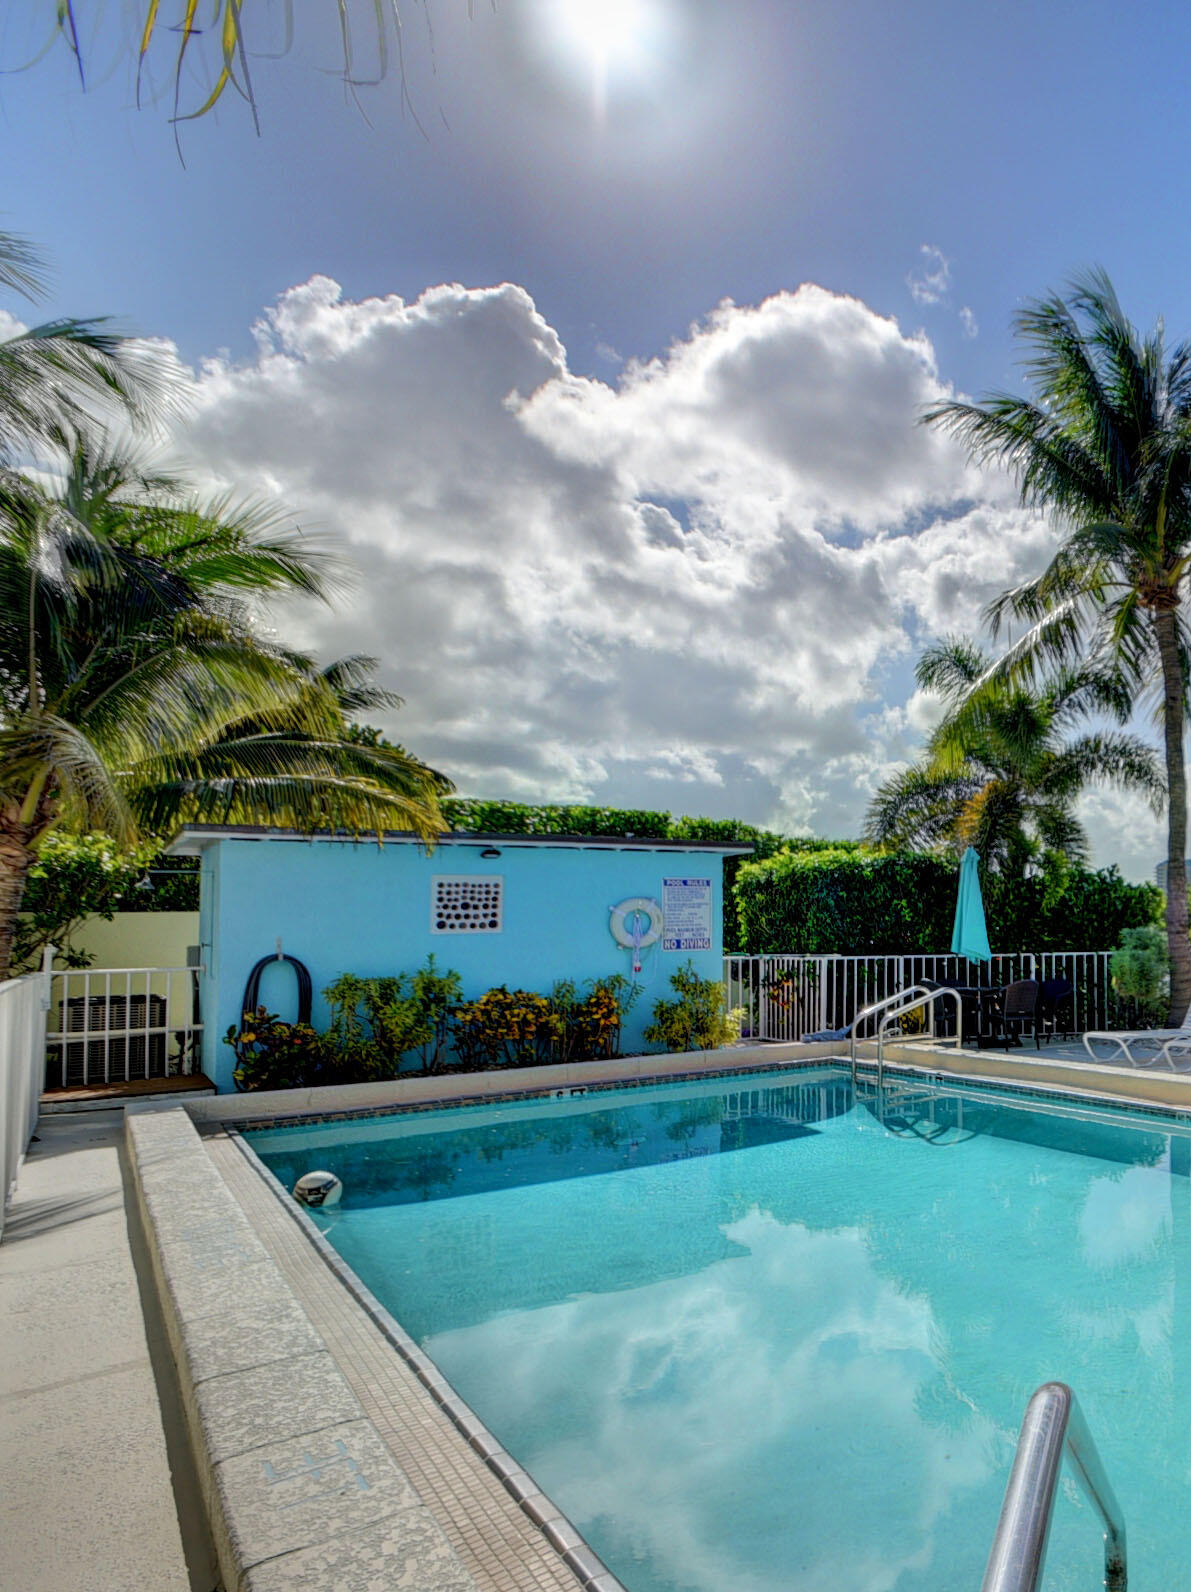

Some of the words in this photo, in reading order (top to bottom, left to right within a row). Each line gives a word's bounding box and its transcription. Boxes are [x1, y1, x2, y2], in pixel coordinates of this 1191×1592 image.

[667, 879, 683, 887] POOL
[687, 879, 707, 887] RULES
[664, 939, 677, 949] NO
[680, 939, 709, 949] DIVING
